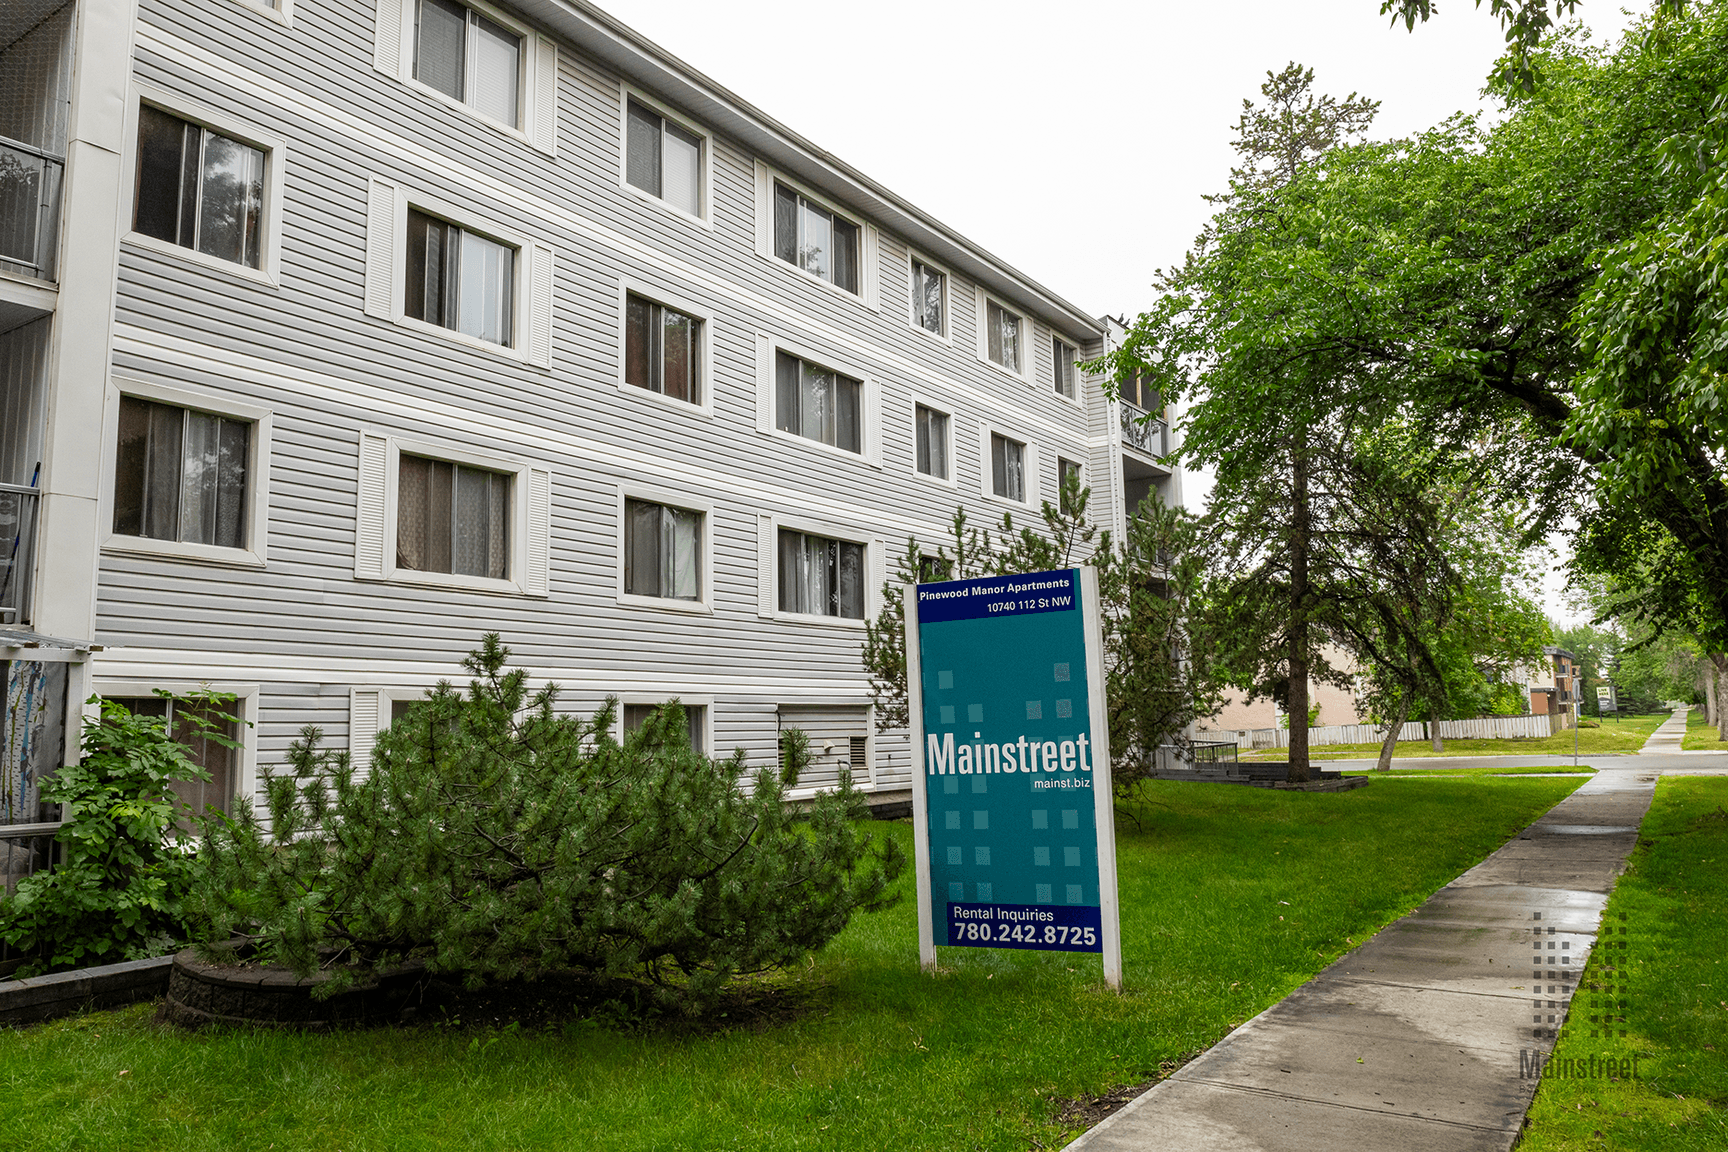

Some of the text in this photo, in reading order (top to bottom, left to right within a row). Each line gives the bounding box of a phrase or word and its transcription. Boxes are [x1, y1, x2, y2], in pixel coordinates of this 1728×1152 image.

[919, 578, 1070, 601] Pinewood Manor Apartments
[987, 596, 1071, 613] 10740 112 St NW
[927, 731, 1091, 775] Mainstreet
[1034, 777, 1091, 788] mainst.biz
[953, 906, 1054, 923] Rental Inquiries
[954, 922, 1096, 946] 780.242.8725
